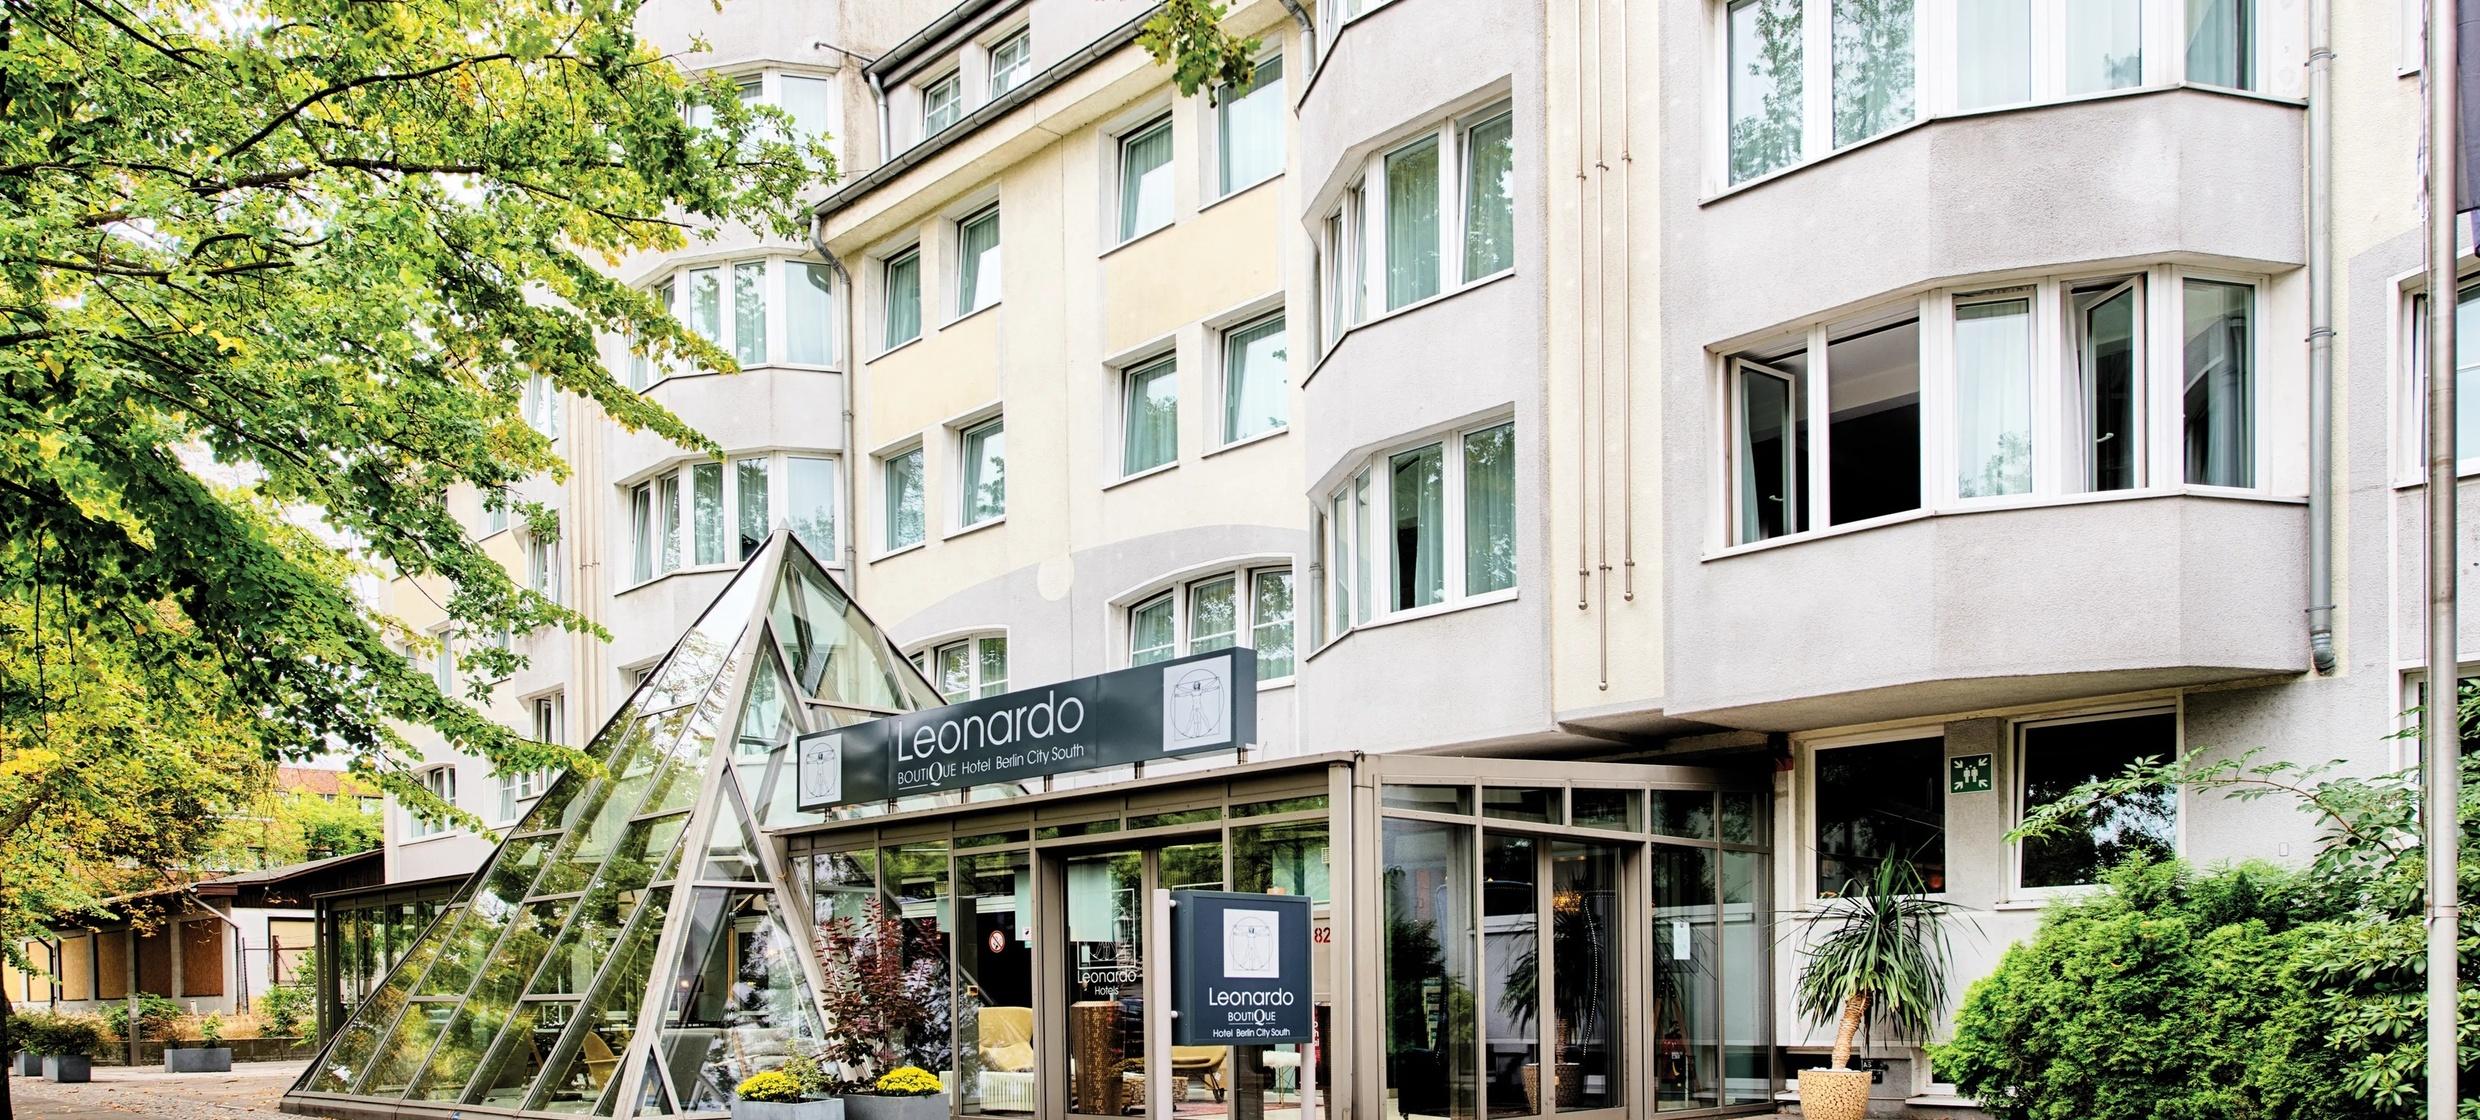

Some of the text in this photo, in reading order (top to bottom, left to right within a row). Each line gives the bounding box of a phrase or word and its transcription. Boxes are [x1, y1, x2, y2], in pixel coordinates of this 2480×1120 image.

[898, 691, 1085, 762] Leonardo
[897, 743, 1085, 787] BOUTIQUE Hotel Berlin City South
[1077, 969, 1137, 984] Leonardo
[1094, 985, 1119, 996] Hotels
[1208, 986, 1294, 1006] Leonardo
[1227, 1008, 1276, 1026] BOUTIQUE
[1212, 1027, 1291, 1039] Hotel Berlin City South
